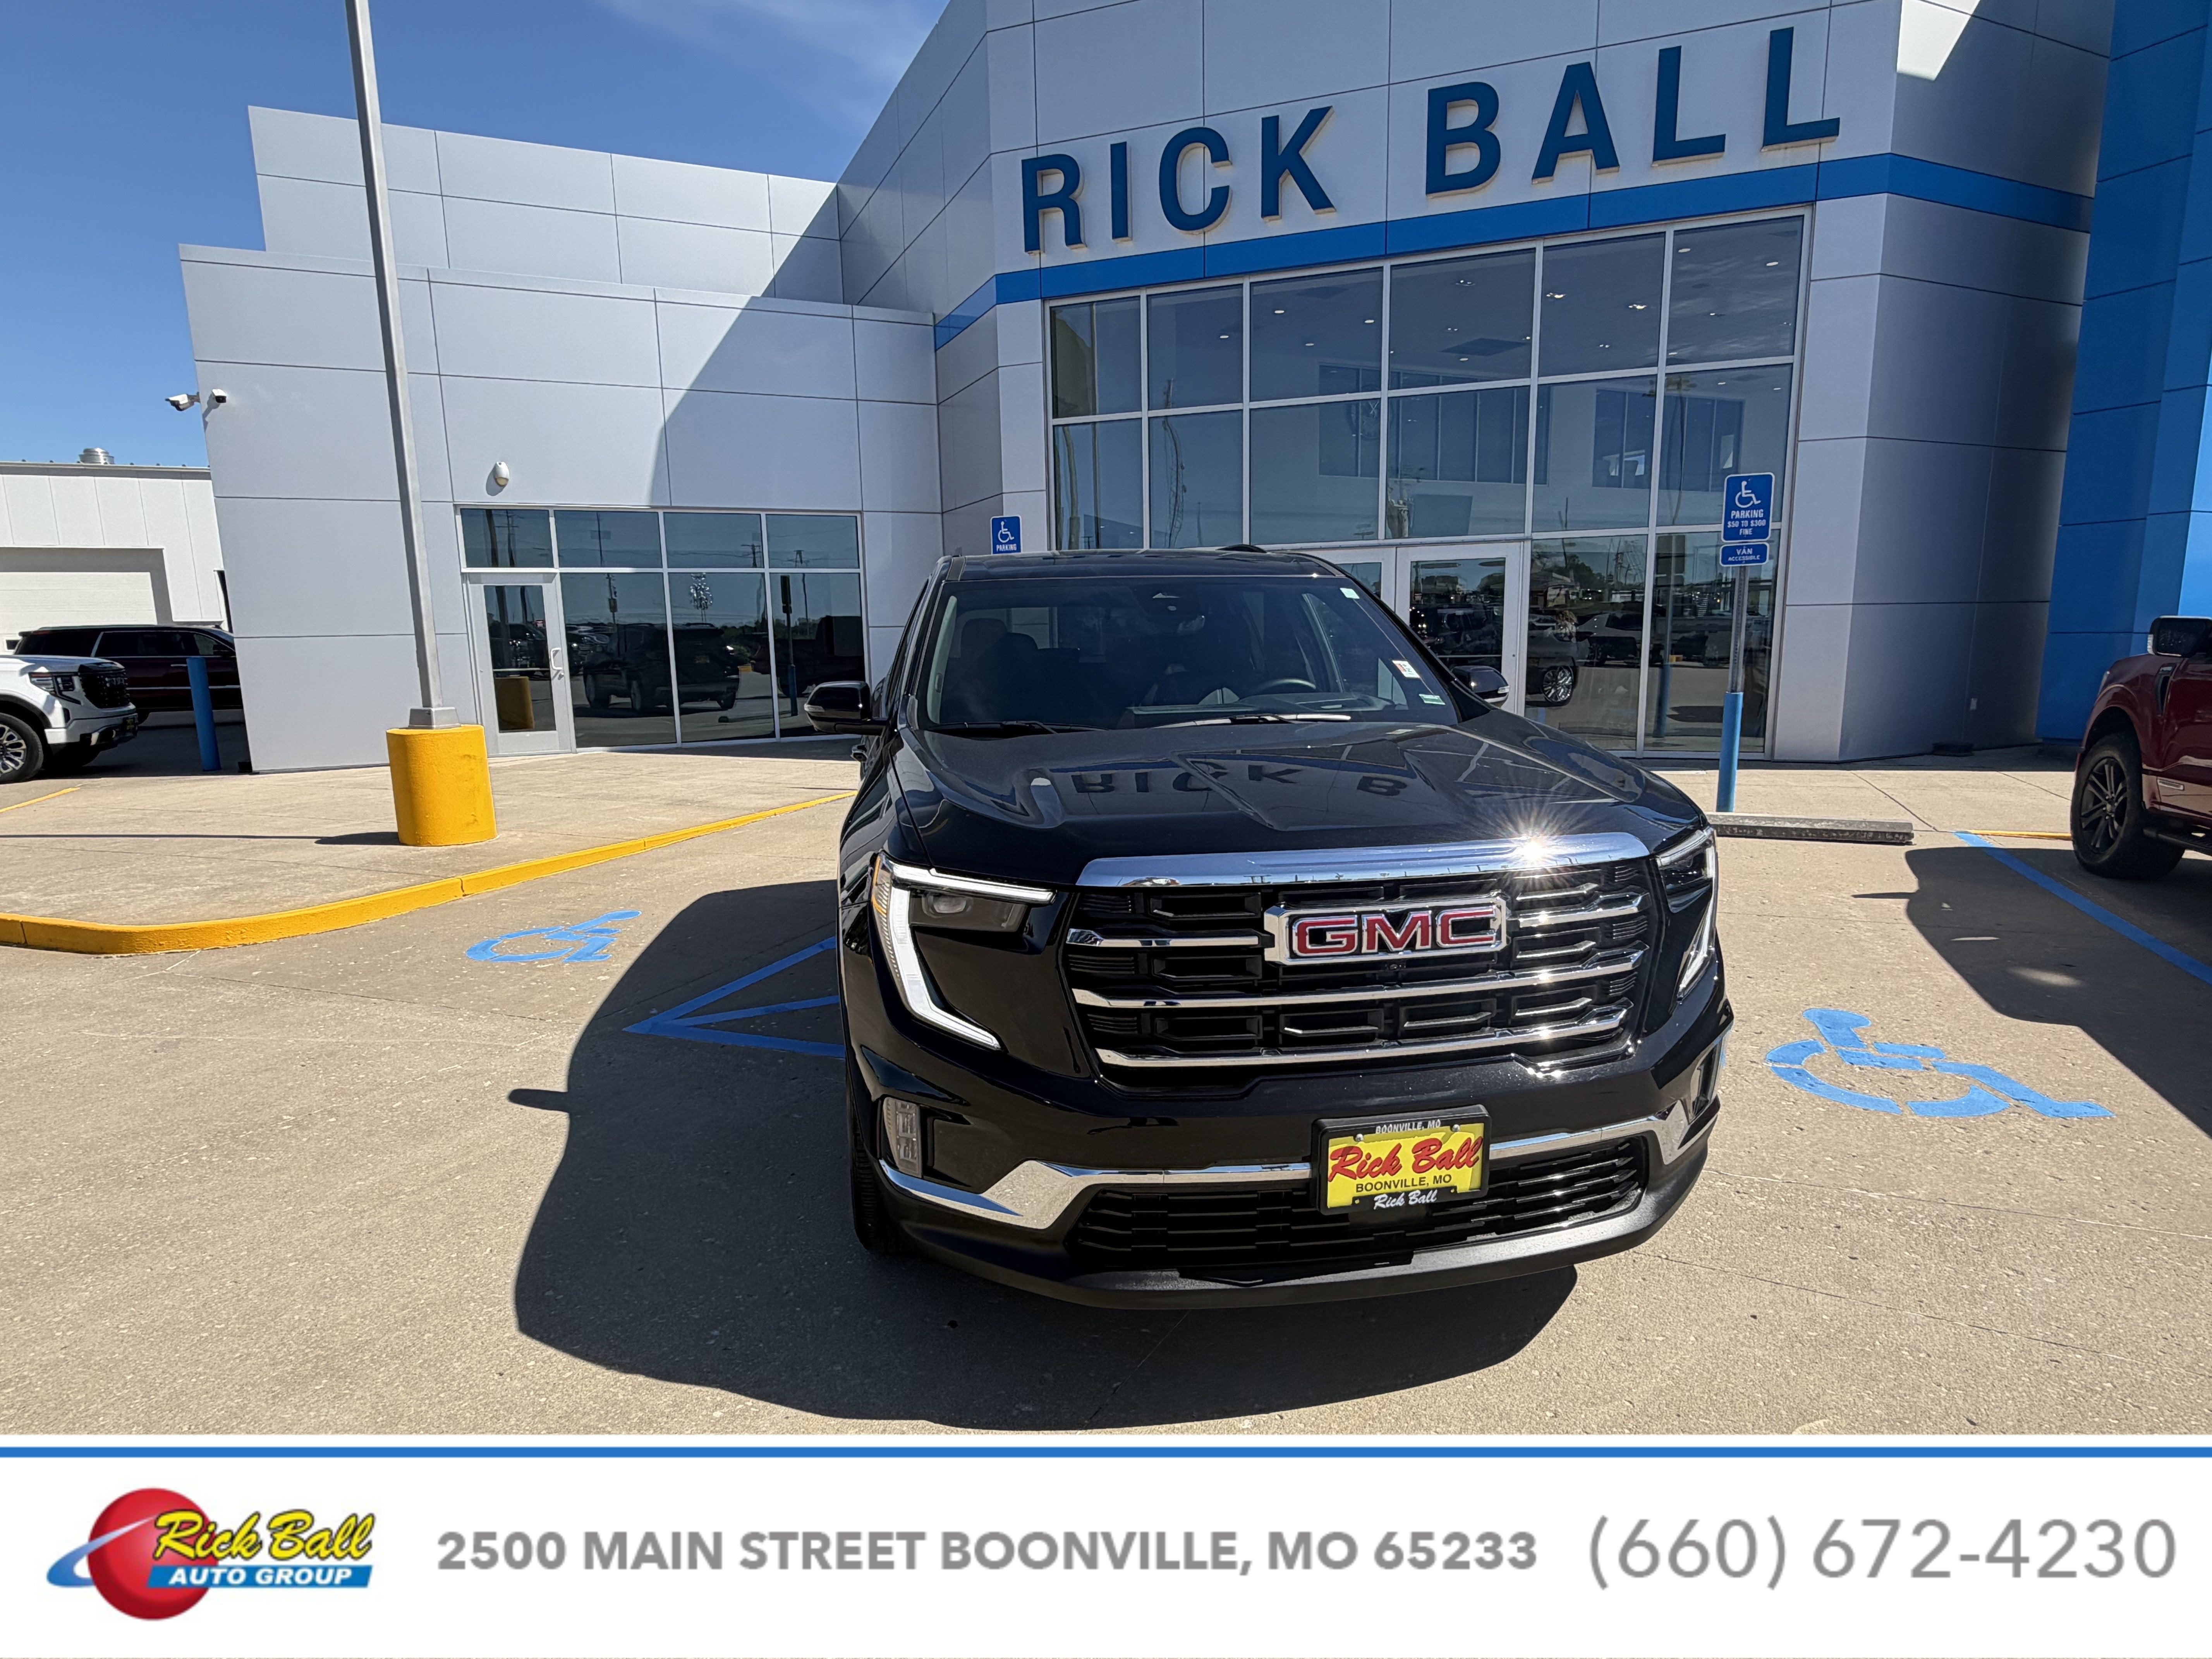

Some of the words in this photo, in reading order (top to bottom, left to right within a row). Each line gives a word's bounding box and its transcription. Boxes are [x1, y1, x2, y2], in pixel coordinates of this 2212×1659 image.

[1020, 105, 1337, 254] RICK
[1425, 26, 1841, 196] BALL
[1731, 509, 1764, 519] PARKING
[996, 544, 1017, 552] PARKING
[1292, 905, 1496, 957] GMC
[1375, 1121, 1425, 1134] BOONVILLE,
[1427, 1119, 1442, 1129] MO
[1328, 1142, 1403, 1182] Rick
[1412, 1136, 1483, 1174] Ball
[1356, 1176, 1429, 1193] BOONVILLE,
[1433, 1174, 1452, 1185] MO
[1373, 1192, 1405, 1210] Rick
[1408, 1189, 1438, 1205] Ball
